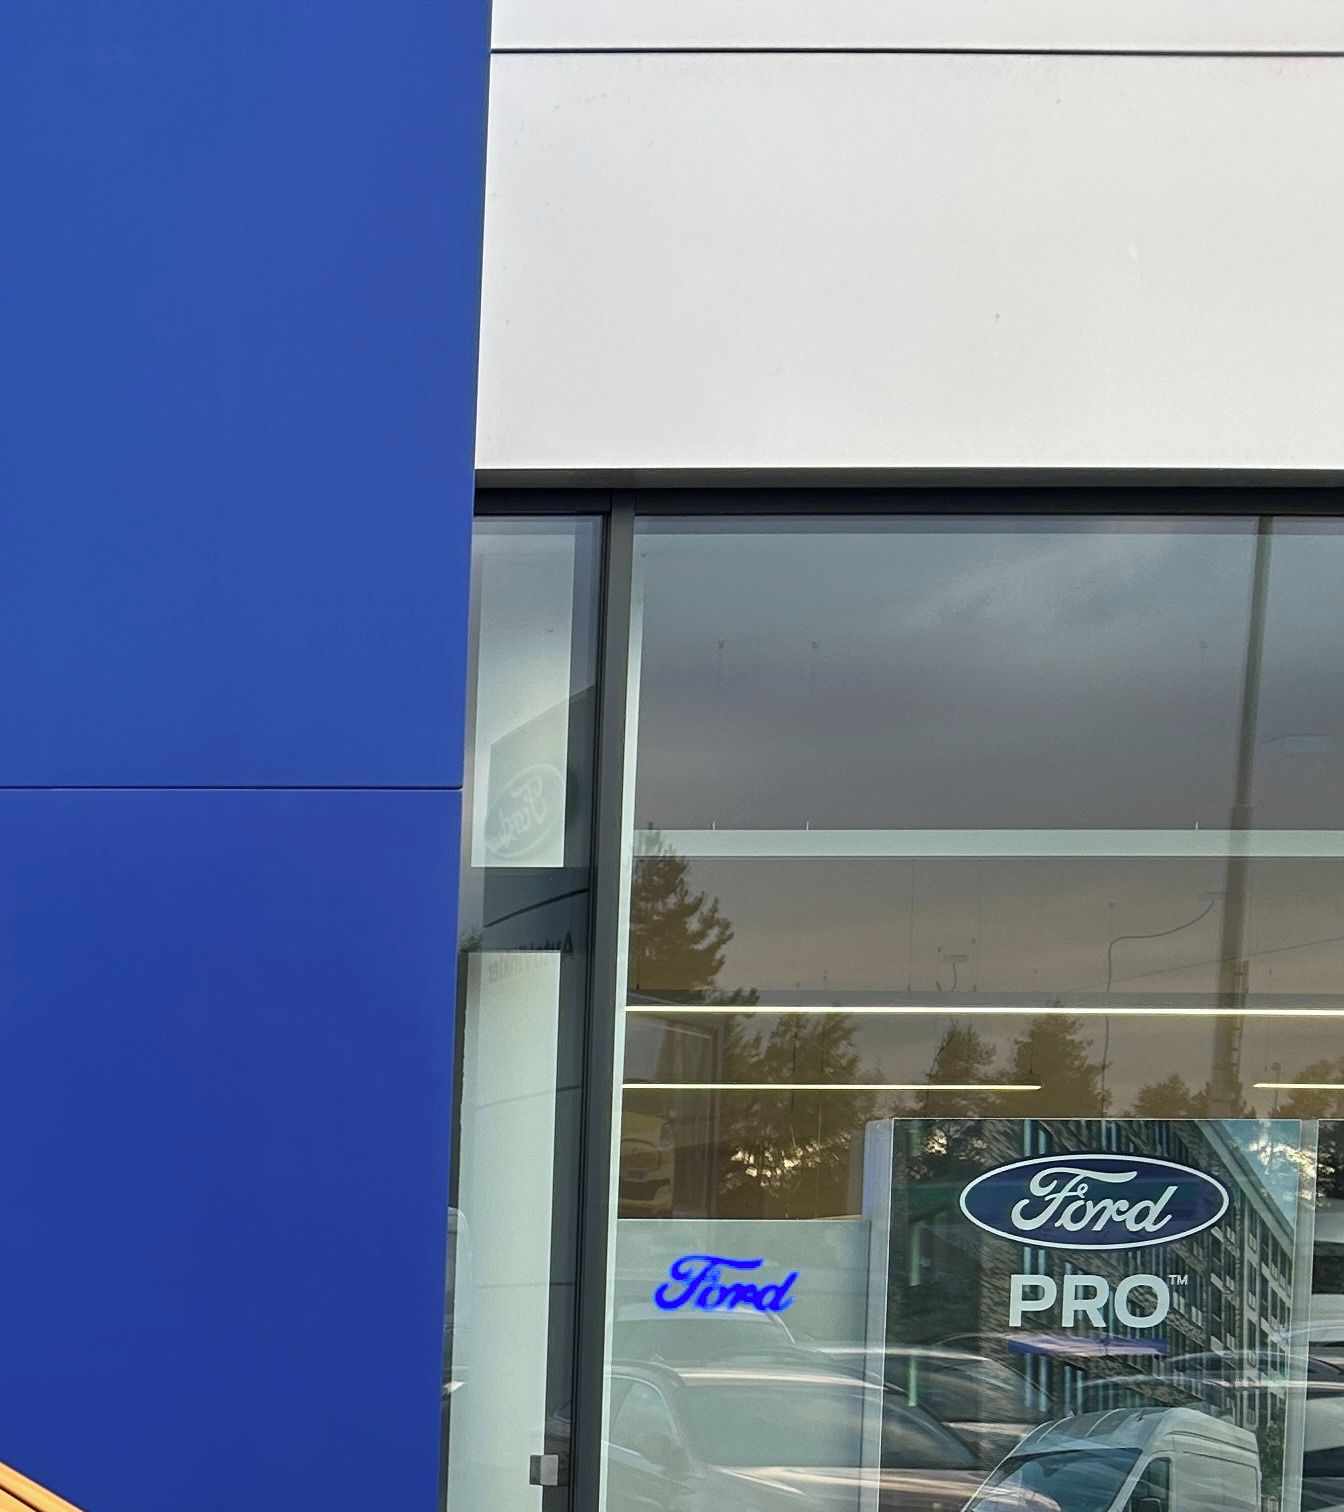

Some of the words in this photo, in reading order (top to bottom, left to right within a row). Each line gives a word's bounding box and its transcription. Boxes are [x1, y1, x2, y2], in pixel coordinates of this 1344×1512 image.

[1011, 1167, 1178, 1233] Ford
[653, 1255, 800, 1312] Ford
[1009, 1274, 1170, 1328] PRO
